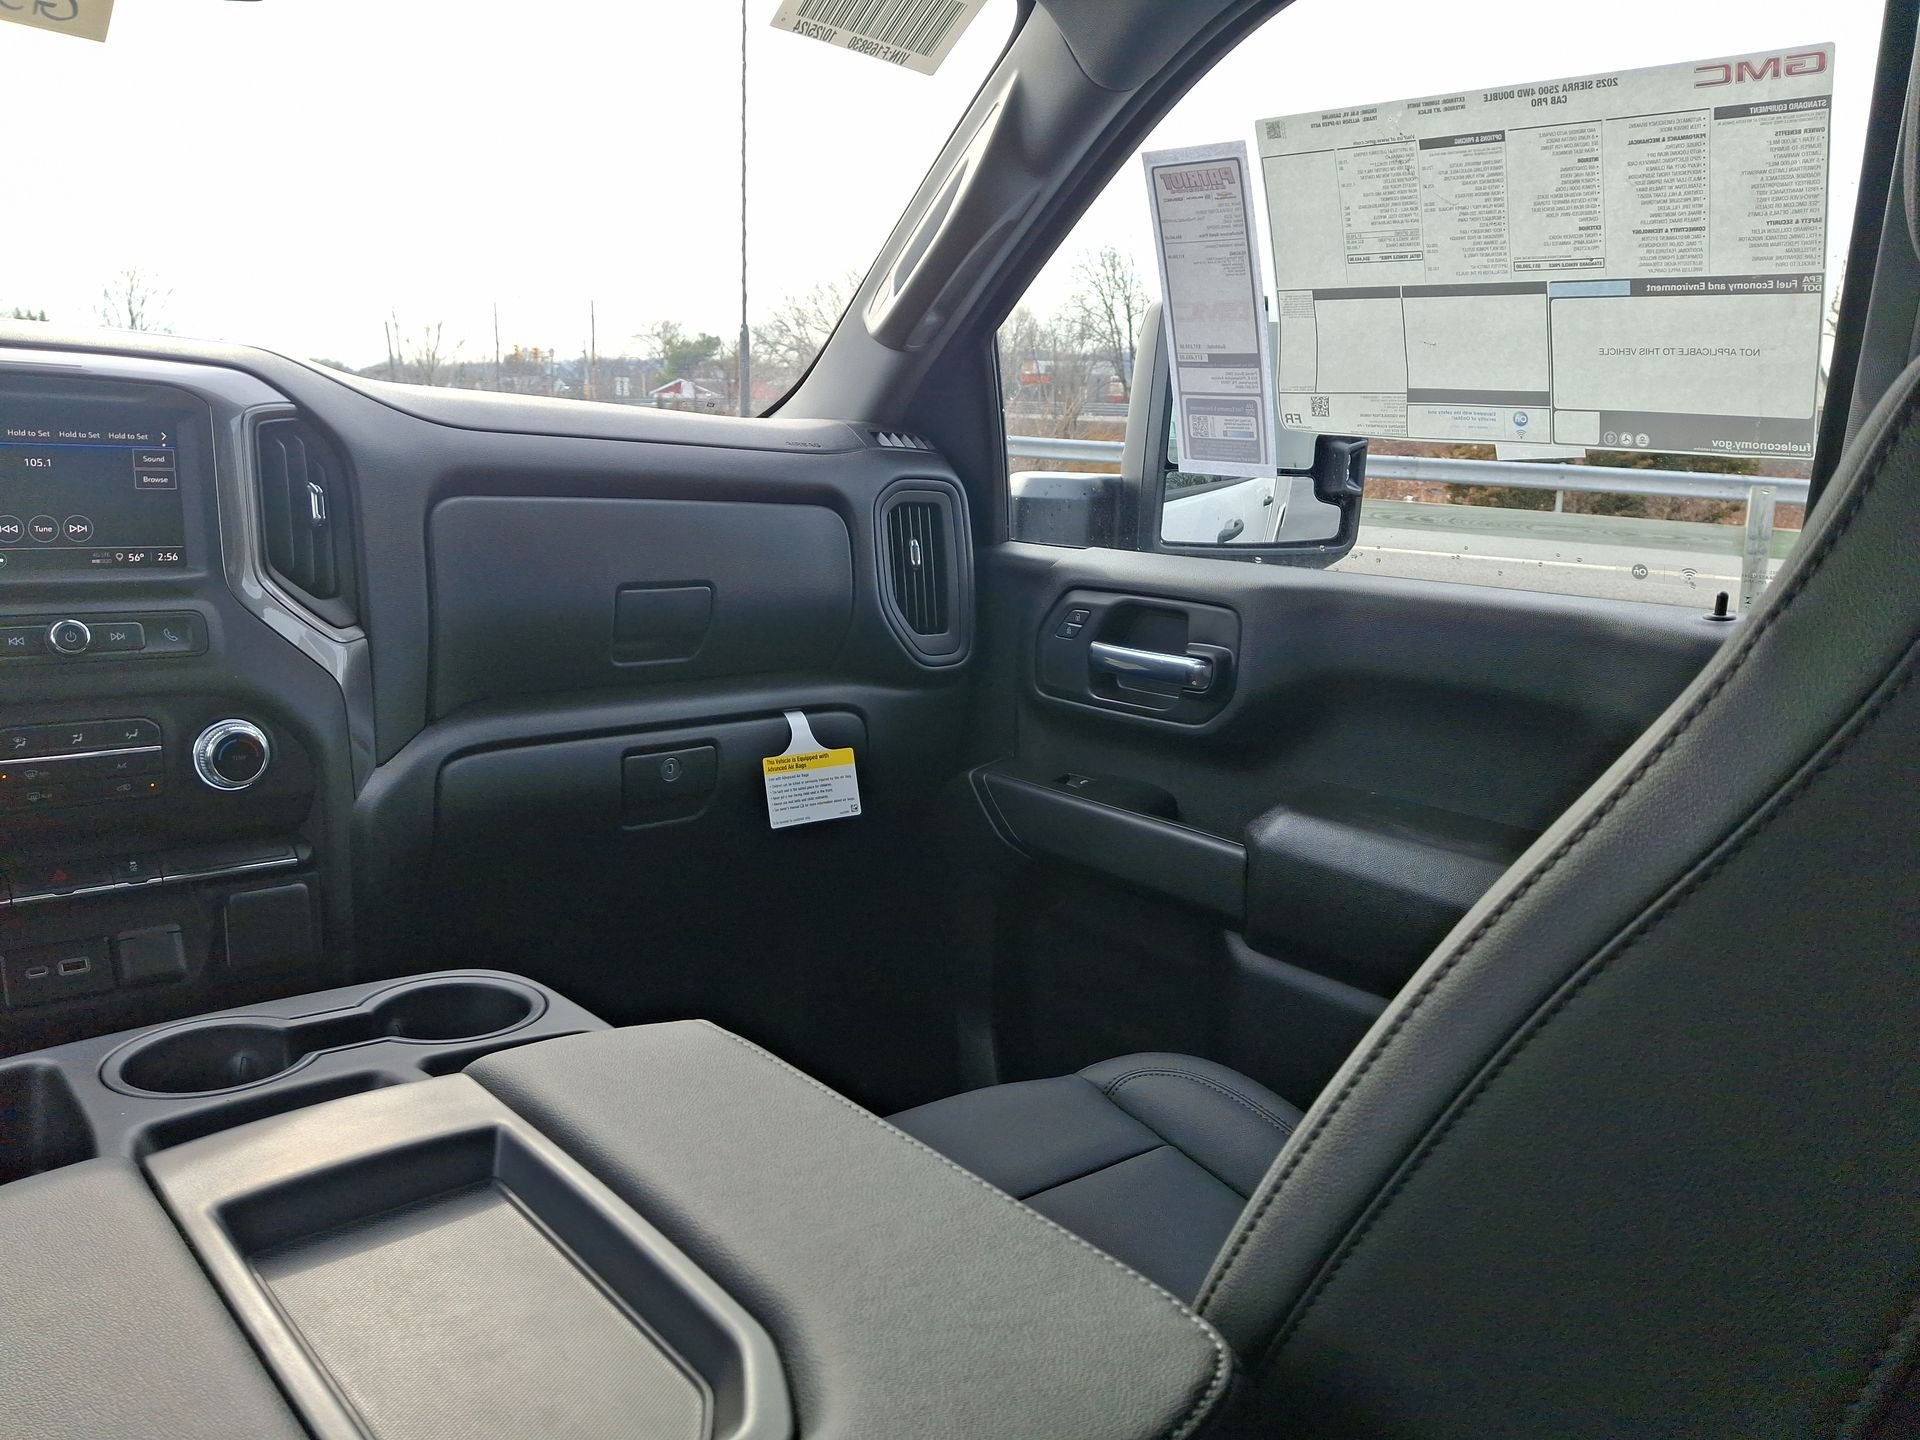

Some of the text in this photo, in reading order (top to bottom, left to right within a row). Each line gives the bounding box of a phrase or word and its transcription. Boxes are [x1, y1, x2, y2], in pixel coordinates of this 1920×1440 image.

[24, 458, 51, 467] 105.1
[158, 553, 178, 561] 2:56
[797, 754, 818, 763] Equipped
